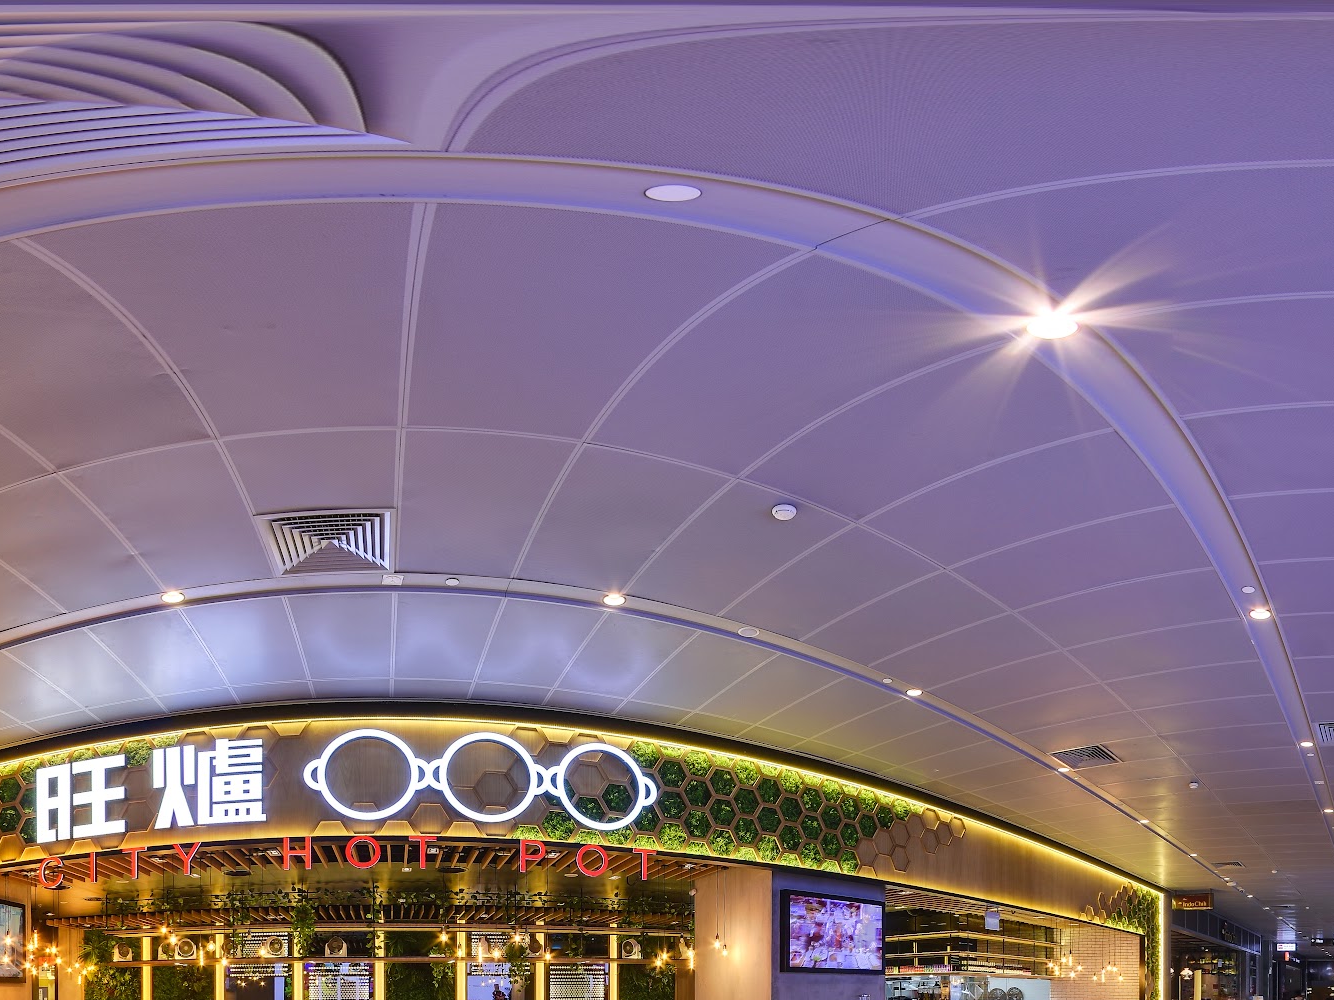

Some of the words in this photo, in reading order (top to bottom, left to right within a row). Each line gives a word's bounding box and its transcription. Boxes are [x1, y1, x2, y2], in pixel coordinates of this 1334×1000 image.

[36, 738, 267, 843] 旺爐
[38, 841, 202, 888] CITY
[282, 835, 438, 871] HOT
[519, 839, 658, 881] POT
